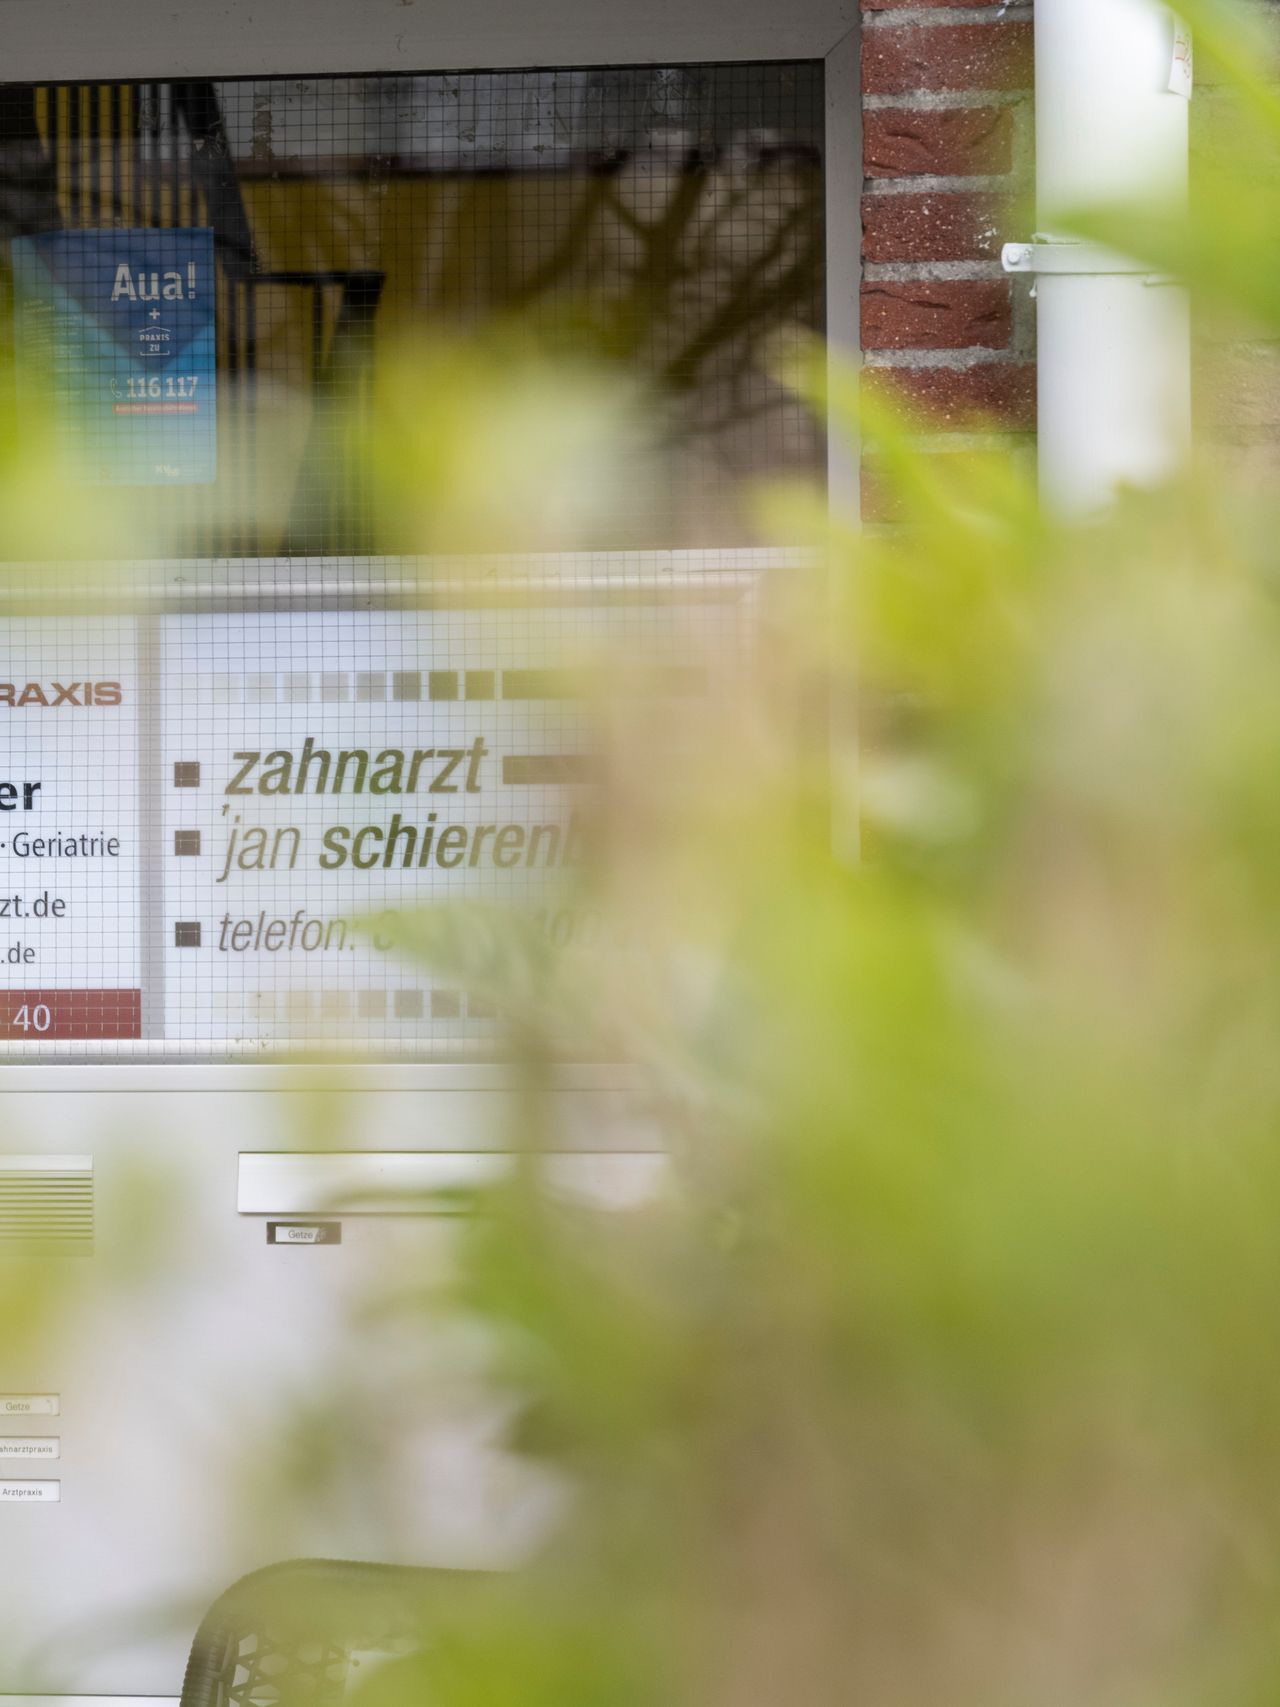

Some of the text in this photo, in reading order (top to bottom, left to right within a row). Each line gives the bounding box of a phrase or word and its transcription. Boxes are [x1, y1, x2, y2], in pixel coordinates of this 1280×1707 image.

[111, 262, 196, 301] Aua!
[126, 376, 199, 398] 116 117
[225, 737, 488, 796] zahnarzt
[12, 832, 120, 858] Geriatrie
[216, 815, 302, 883] jan
[220, 909, 356, 952] telefon:
[13, 1004, 51, 1031] 40
[2, 1488, 42, 1497] Arztpraxis
